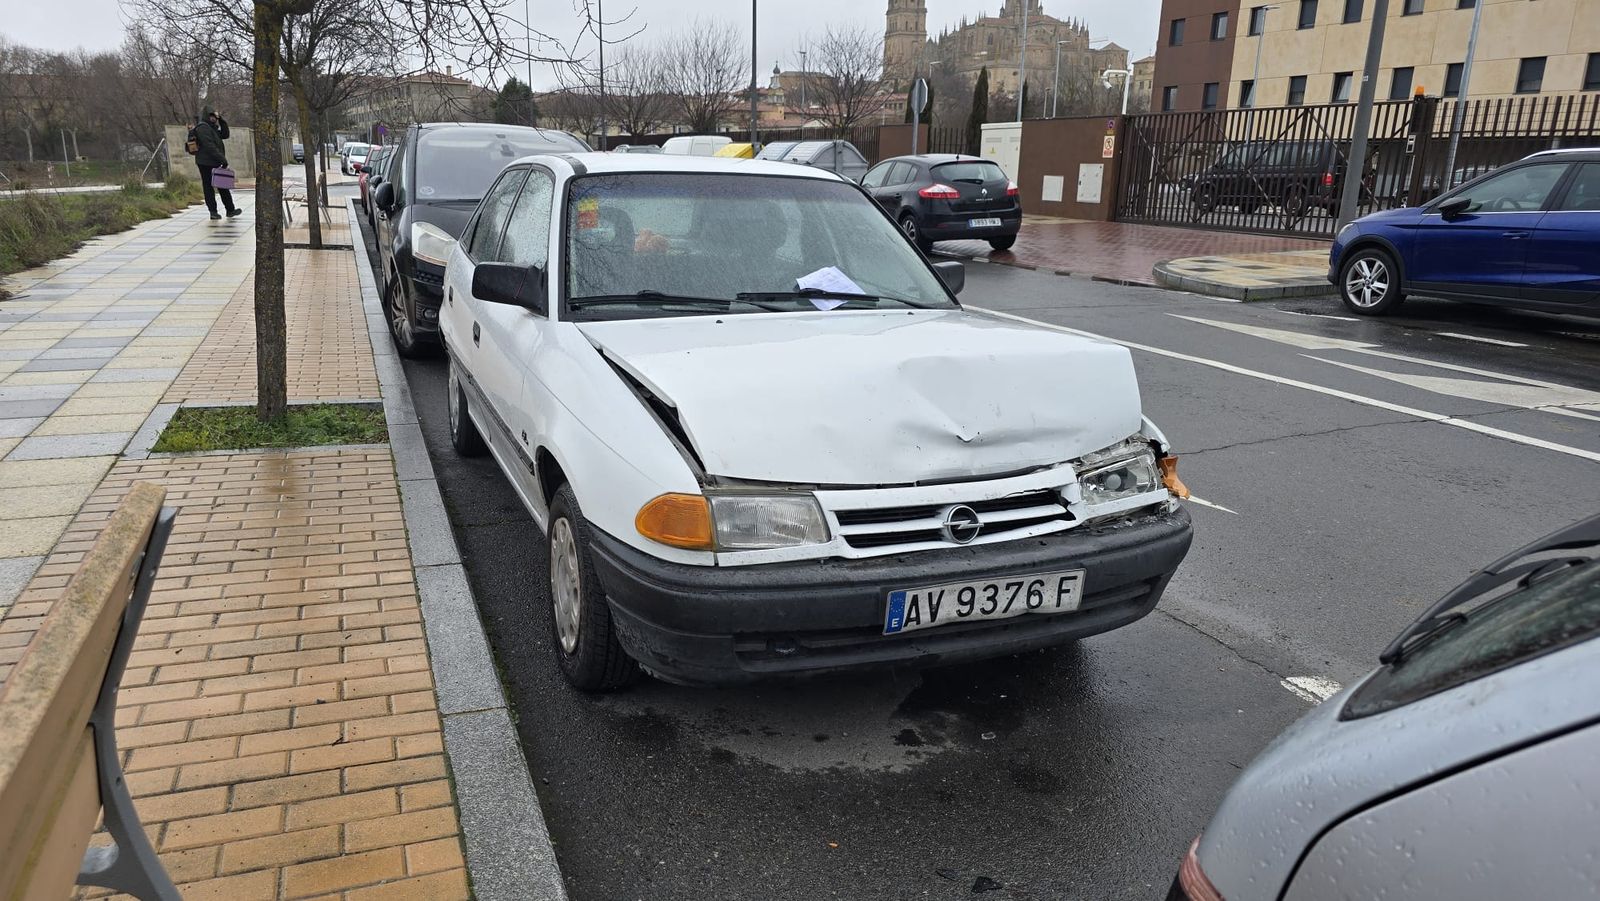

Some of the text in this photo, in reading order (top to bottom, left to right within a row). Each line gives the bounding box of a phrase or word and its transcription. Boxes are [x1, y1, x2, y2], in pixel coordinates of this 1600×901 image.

[903, 575, 1078, 627] AV 9376 F
[891, 618, 899, 628] E
